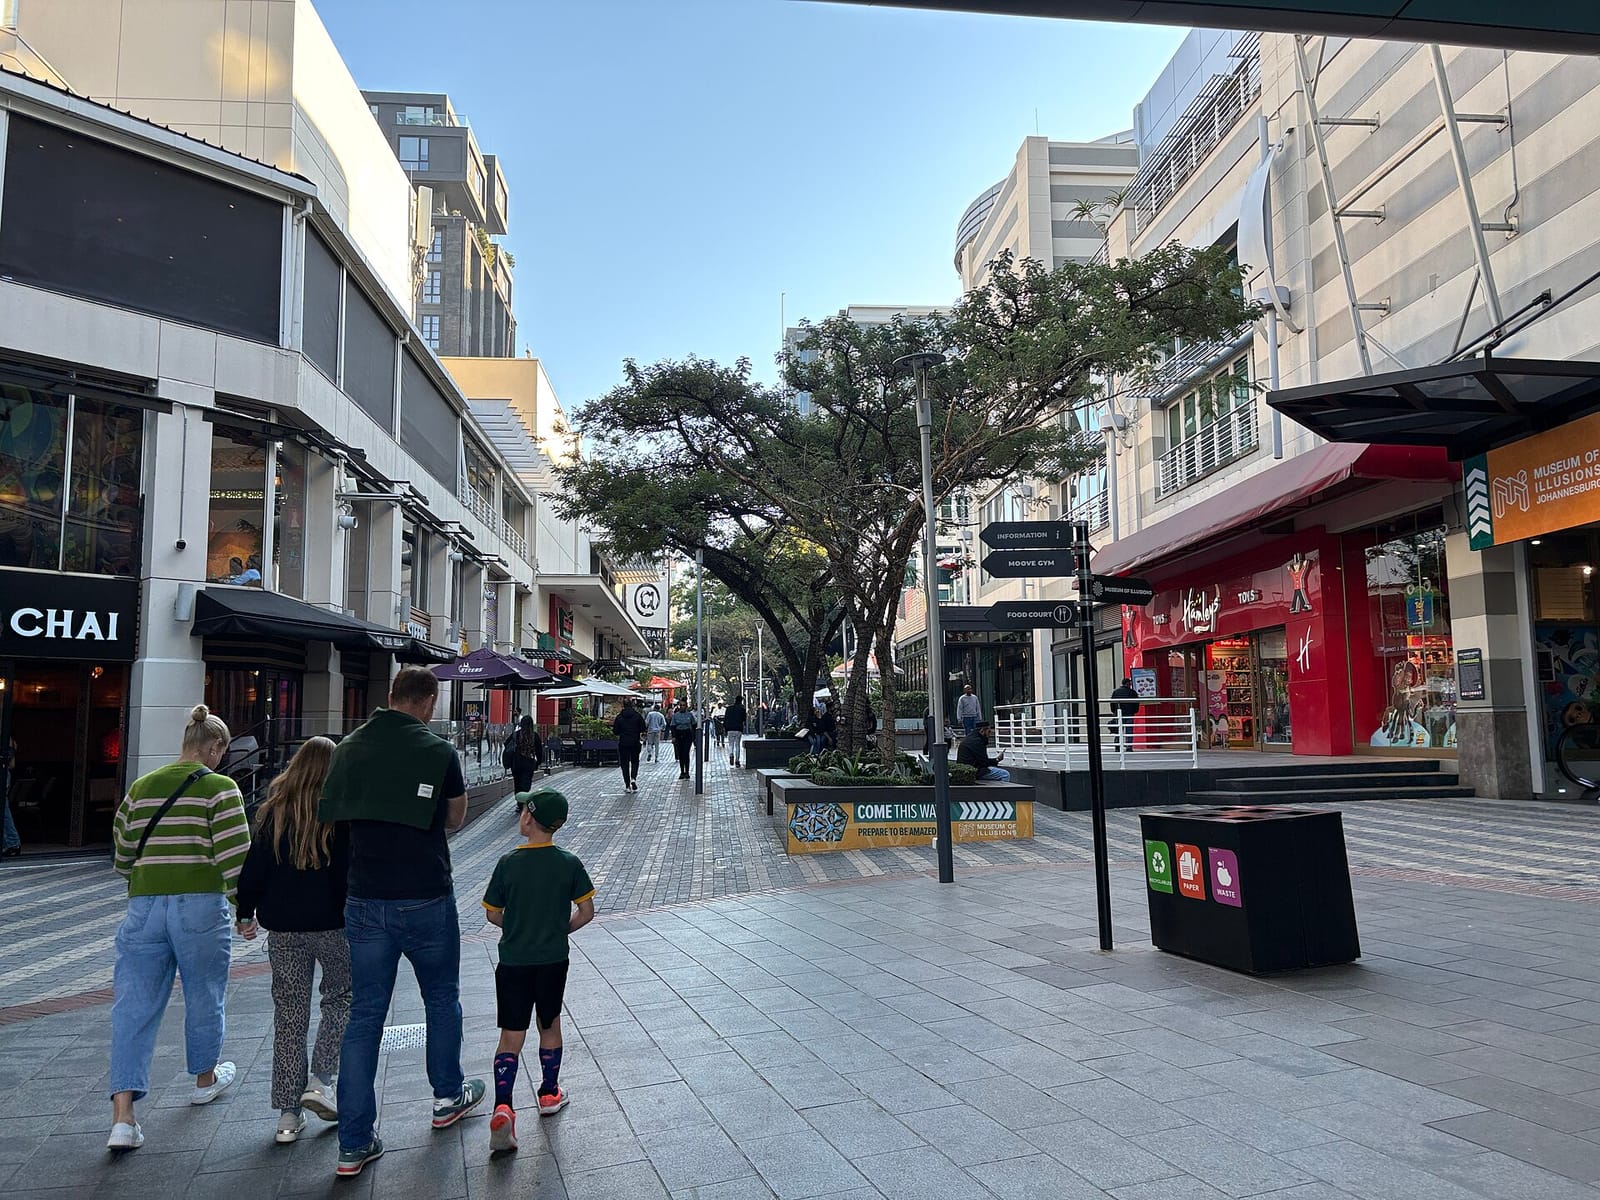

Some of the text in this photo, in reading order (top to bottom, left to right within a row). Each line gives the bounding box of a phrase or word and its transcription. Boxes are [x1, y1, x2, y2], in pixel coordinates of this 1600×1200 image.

[1533, 449, 1600, 479] MUSEUM OF
[1535, 463, 1600, 493] ILLUSIONS
[997, 532, 1048, 540] INFORMATION
[1181, 585, 1220, 633] Hamleys
[10, 607, 119, 641] CHAI
[857, 803, 936, 819] COME THIS WA
[857, 826, 936, 837] PREPARE TO BE AMAZED
[1183, 882, 1200, 891] PAPER
[1217, 888, 1236, 898] WASTE
